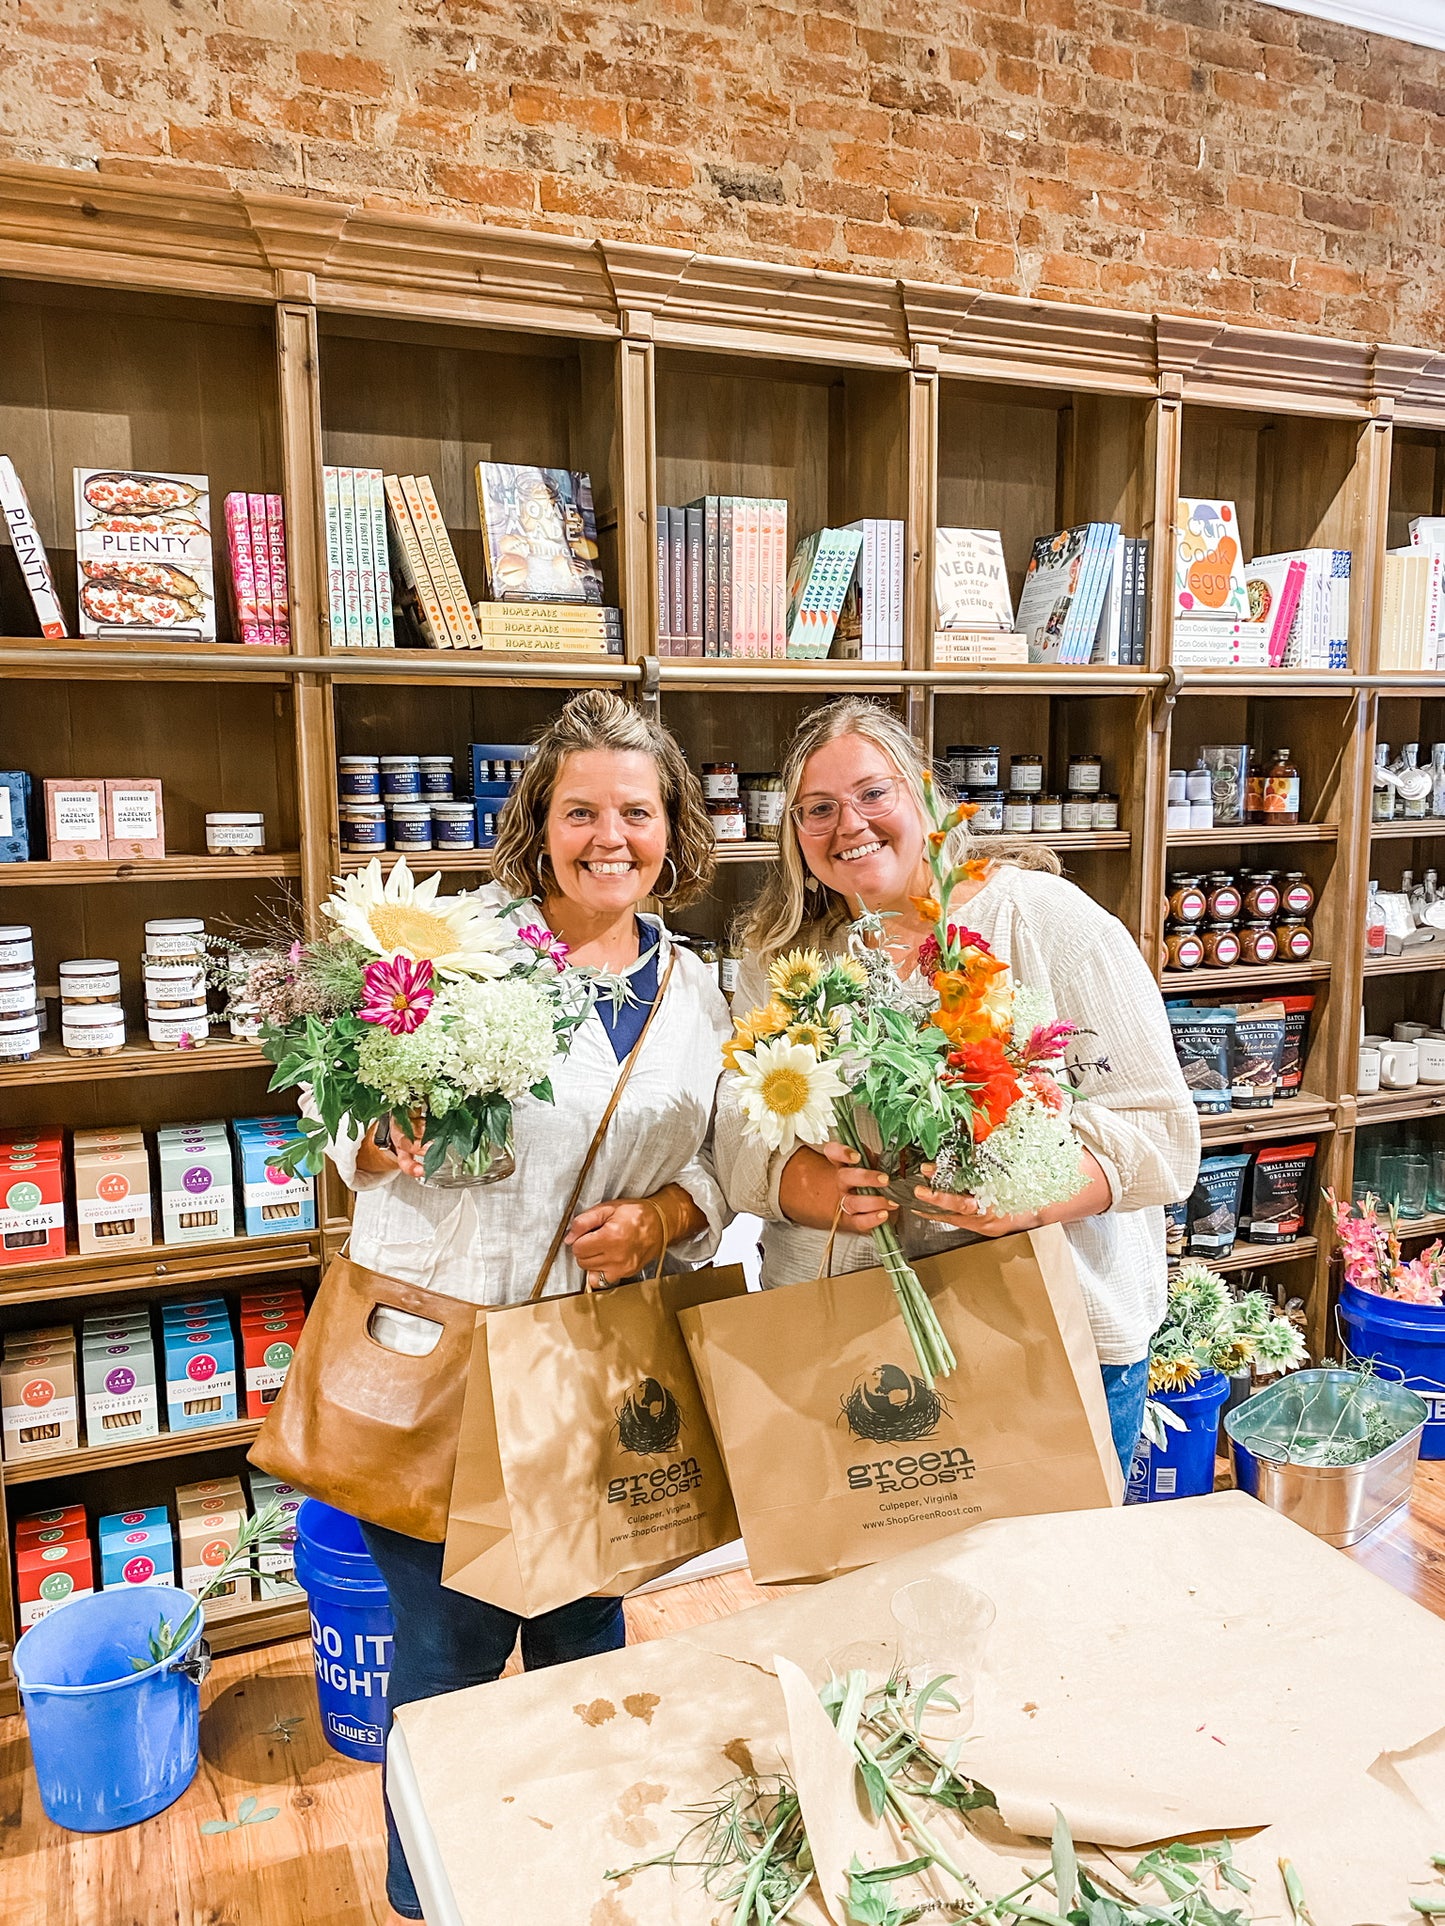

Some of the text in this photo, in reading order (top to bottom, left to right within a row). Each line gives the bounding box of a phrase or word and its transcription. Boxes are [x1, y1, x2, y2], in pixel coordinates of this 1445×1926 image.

[329, 521, 338, 544] FOREST
[360, 523, 369, 545] FOREST
[376, 523, 385, 546] FOREST
[1187, 517, 1227, 538] Can
[6, 508, 50, 596] PLENTY
[102, 535, 191, 553] PLENTY
[235, 524, 252, 565] salad
[252, 525, 269, 565] salad
[270, 526, 284, 565] salad
[1178, 541, 1231, 565] Cook
[330, 547, 339, 565] FEAST
[361, 548, 370, 565] FEAST
[377, 549, 386, 566] FEAST
[811, 549, 826, 581] SALAD
[821, 549, 836, 582] SALAD
[831, 549, 846, 582] SALAD
[842, 550, 856, 582] SALAD
[405, 537, 435, 601] FOREST FEAST
[421, 537, 450, 601] FOREST FEAST
[437, 537, 467, 601] FOREST FEAST
[940, 560, 1000, 580] VEGAN
[1124, 546, 1134, 590] VEGAN
[1137, 546, 1146, 590] VEGAN
[658, 559, 666, 601] Homemade
[675, 542, 683, 632] New Homemade Kitchen
[954, 580, 989, 588] AND KEEP
[1176, 568, 1239, 595] Vegan
[707, 585, 716, 632] GATHERINGS
[722, 585, 731, 632] GATHERINGS
[955, 598, 994, 609] FRIENDS
[658, 603, 666, 631] Kitchen
[1179, 624, 1229, 634] Can Cook Vegan
[1192, 655, 1208, 663] Cook
[1208, 656, 1228, 664] Vegan
[156, 940, 198, 949] SHORTBREAD
[67, 982, 110, 990] SHORTBREAD
[70, 1033, 114, 1041] SHORTBREAD
[160, 1025, 201, 1035] SHORTBREAD
[1200, 1170, 1240, 1183] SMALL BATCH
[1263, 1164, 1284, 1172] SMALL
[1269, 1172, 1302, 1180] ORGANICS
[102, 1184, 126, 1193] LARK
[186, 1176, 209, 1184] LARK
[1206, 1181, 1237, 1191] ORGANICS
[12, 1194, 37, 1202] LARK
[251, 1186, 310, 1198] COCONUT BUTTER
[84, 1209, 125, 1218] CHOCOLATE
[169, 1198, 225, 1209] SHORTBREAD
[268, 1353, 289, 1361] LARK
[191, 1364, 213, 1372] LARK
[109, 1377, 132, 1385] LARK
[172, 1381, 231, 1395] COCONUT BUTTER
[255, 1376, 285, 1386] CHA-C
[26, 1390, 50, 1399] LARK
[93, 1397, 149, 1410] SHORTBREAD
[9, 1413, 50, 1424] CHOCOLATE
[847, 1447, 974, 1489] green
[607, 1456, 701, 1504] green
[876, 1466, 976, 1494] ROOST
[630, 1475, 703, 1507] ROOST
[879, 1492, 958, 1512] Culpeper, Virginia
[627, 1502, 691, 1525] Culpeper, Virginia
[862, 1504, 983, 1530] www.ShopGreenRoost.com
[609, 1511, 708, 1544] www.ShopGreenRoost.com
[127, 1566, 150, 1576] LARK
[266, 1558, 292, 1567] SHORT
[45, 1583, 69, 1592] LARK
[310, 1611, 394, 1666] DO IT
[313, 1647, 390, 1698] RIGHT
[332, 1716, 378, 1743] LOWE'S
